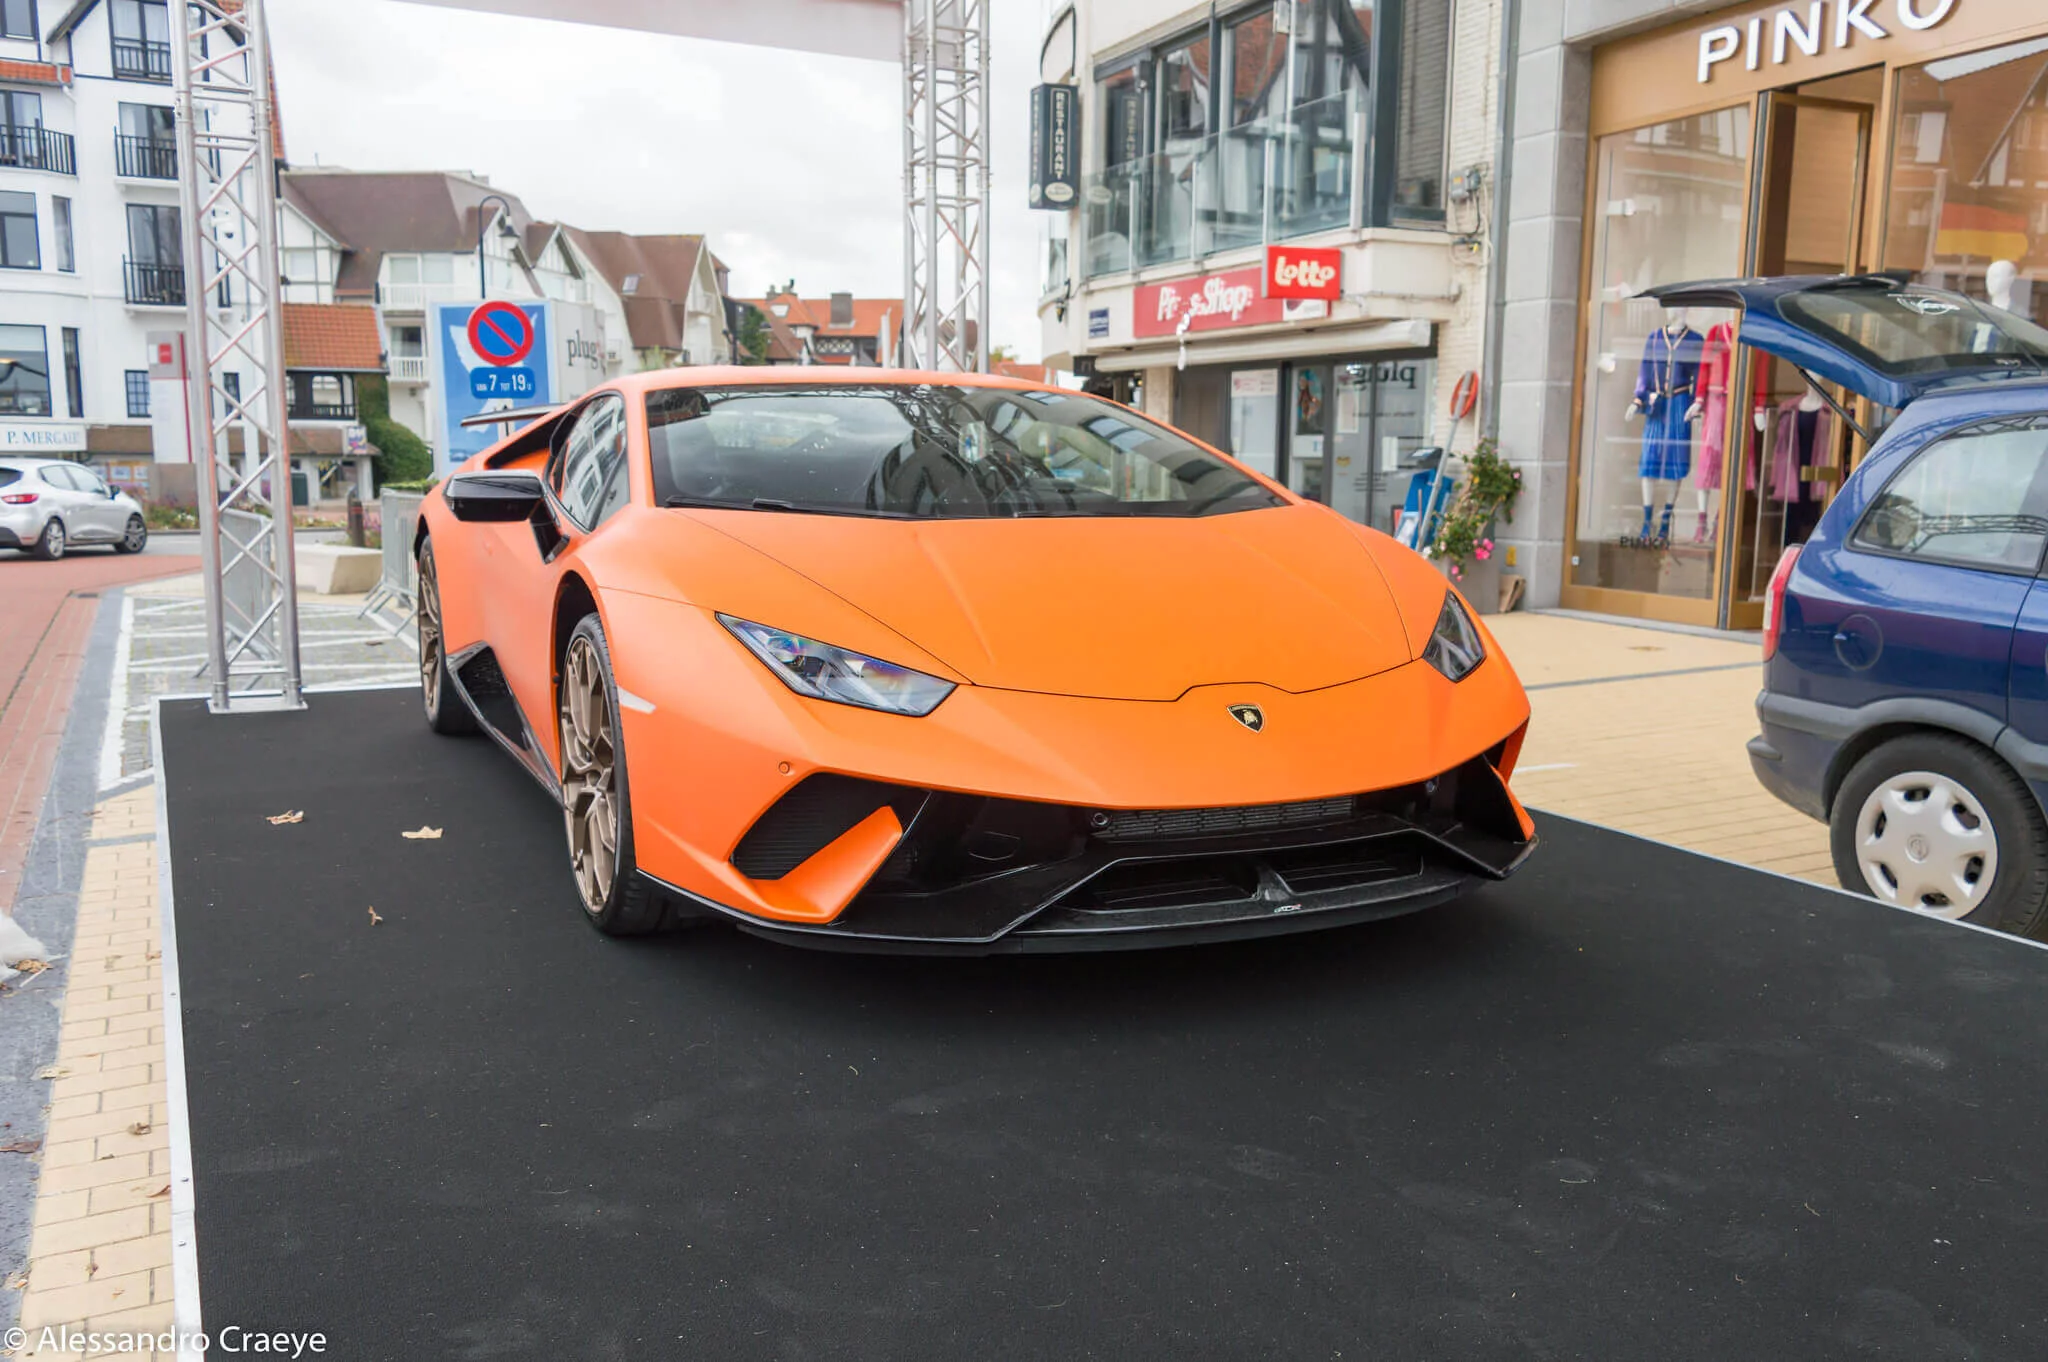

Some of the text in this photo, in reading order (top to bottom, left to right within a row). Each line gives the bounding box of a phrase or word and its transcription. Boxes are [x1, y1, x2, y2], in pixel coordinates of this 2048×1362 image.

[1697, 0, 1956, 83] PINKO
[1055, 92, 1065, 180] RESTAURANT
[1274, 256, 1335, 288] Lotto
[566, 330, 599, 370] plug
[489, 374, 497, 391] 7
[512, 374, 526, 391] 19
